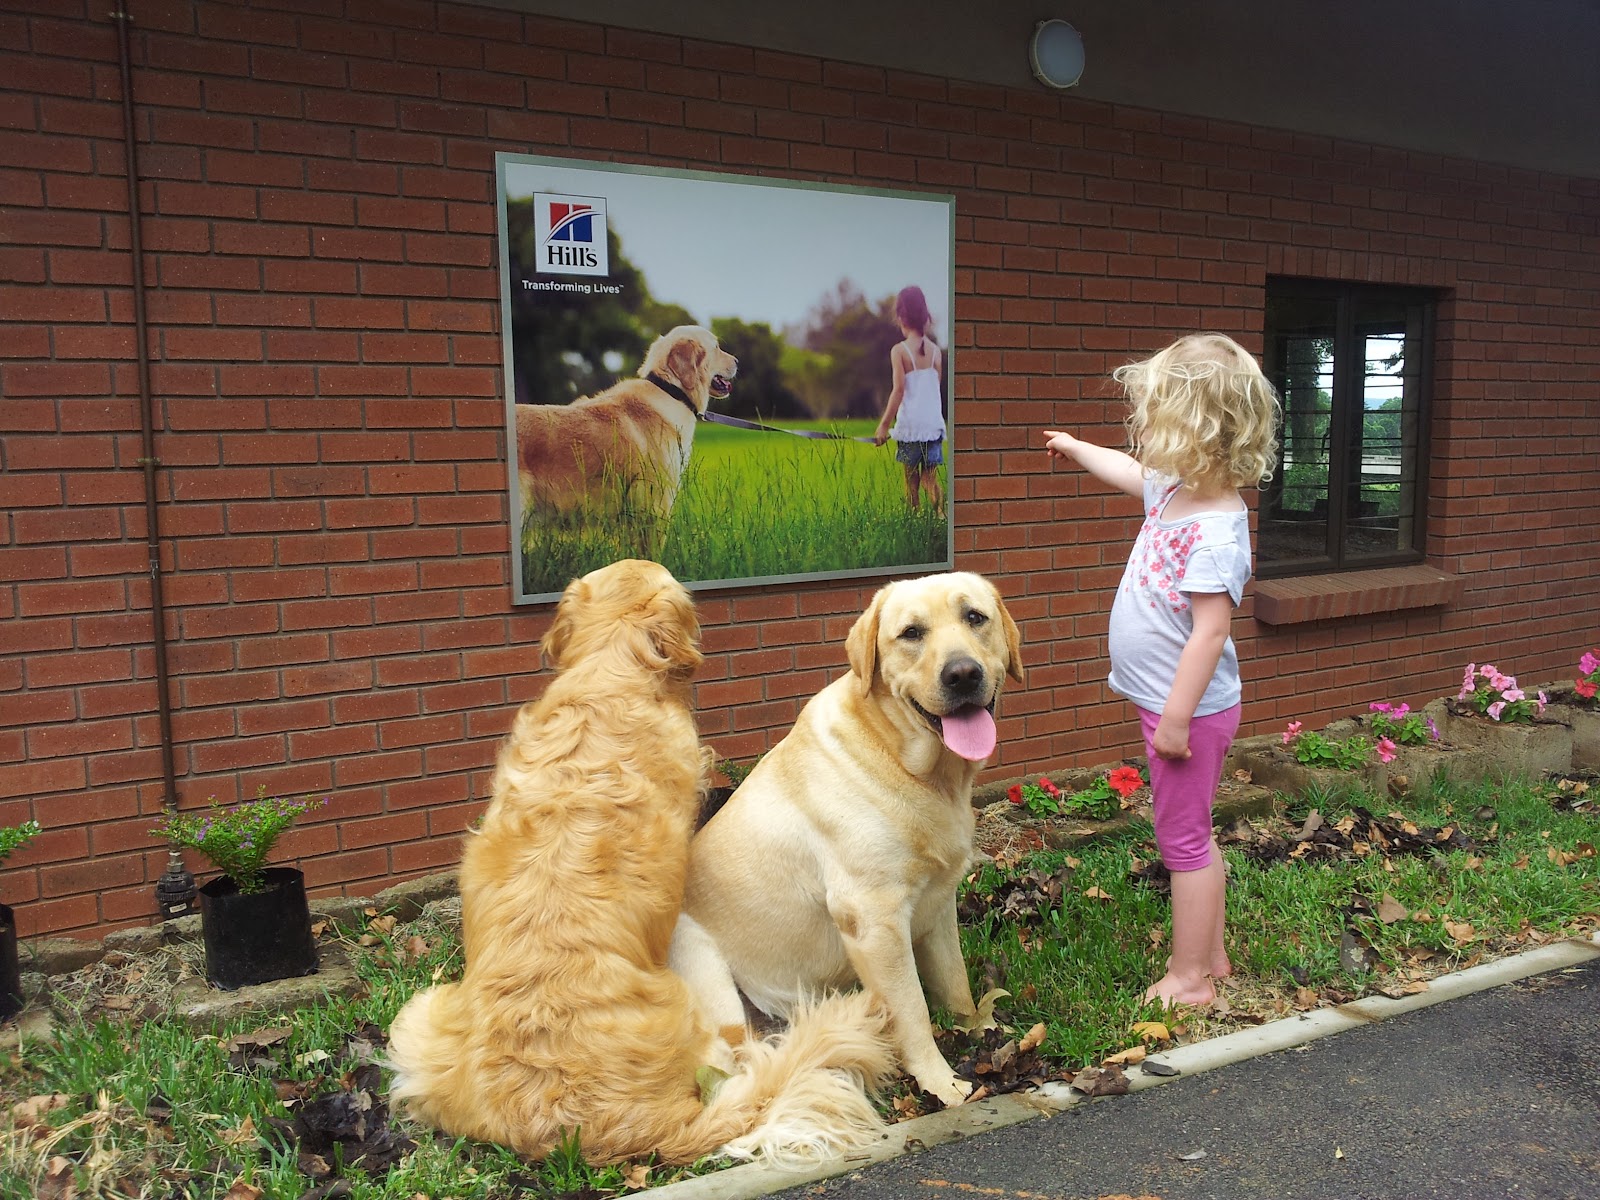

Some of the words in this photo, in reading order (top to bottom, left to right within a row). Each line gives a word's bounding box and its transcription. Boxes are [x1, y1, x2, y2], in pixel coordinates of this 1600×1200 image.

[547, 245, 598, 267] Hill's
[522, 280, 591, 294] Transforming
[593, 283, 620, 294] Lives
